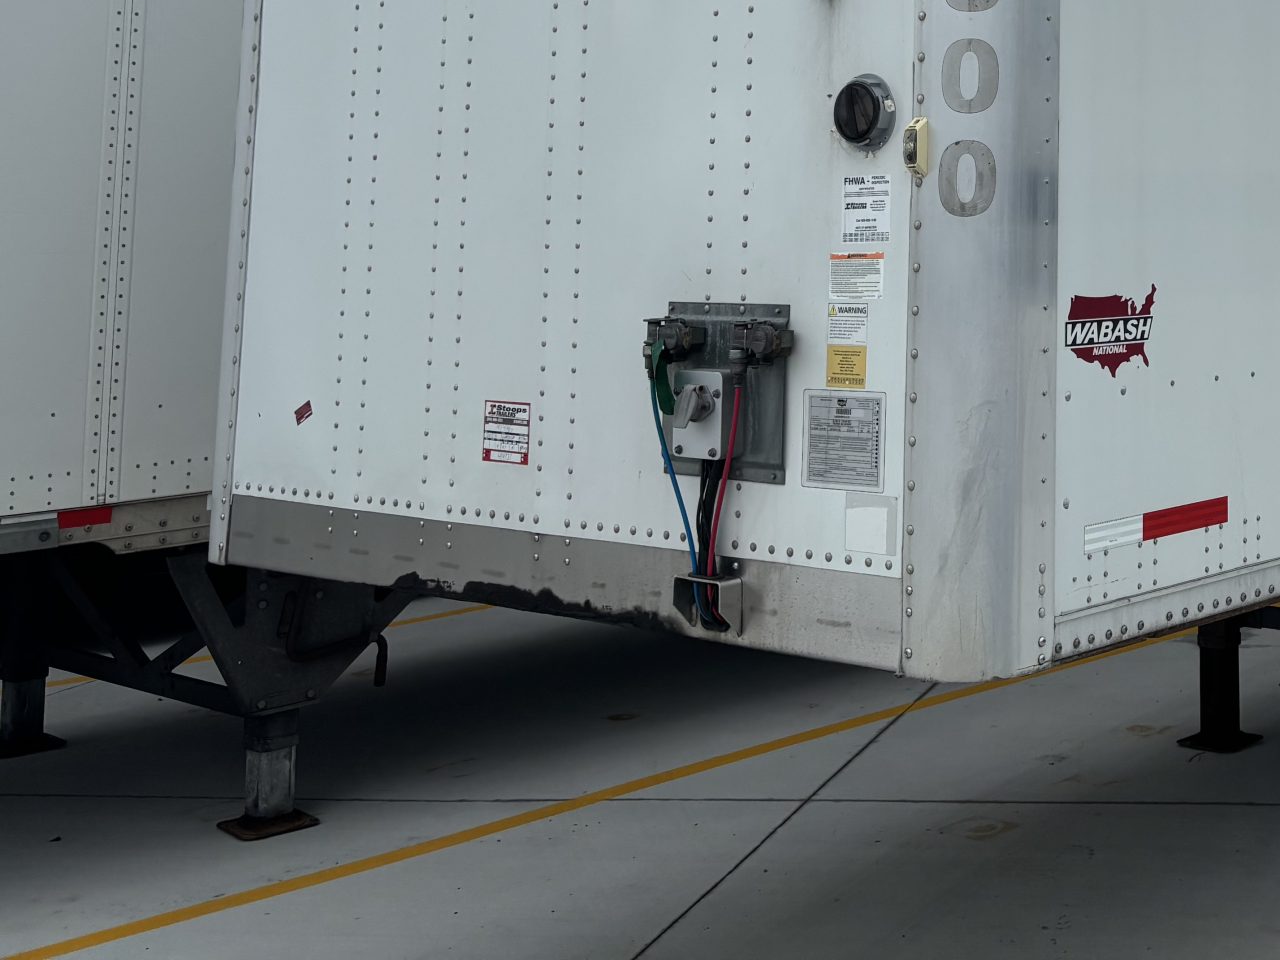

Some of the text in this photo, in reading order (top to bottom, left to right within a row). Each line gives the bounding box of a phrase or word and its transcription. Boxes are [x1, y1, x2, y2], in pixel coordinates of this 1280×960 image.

[844, 177, 865, 186] FHWA
[837, 306, 866, 315] WARNING
[1065, 318, 1152, 345] WABASH
[1092, 344, 1128, 356] NATIONAL
[497, 404, 528, 415] Stoops
